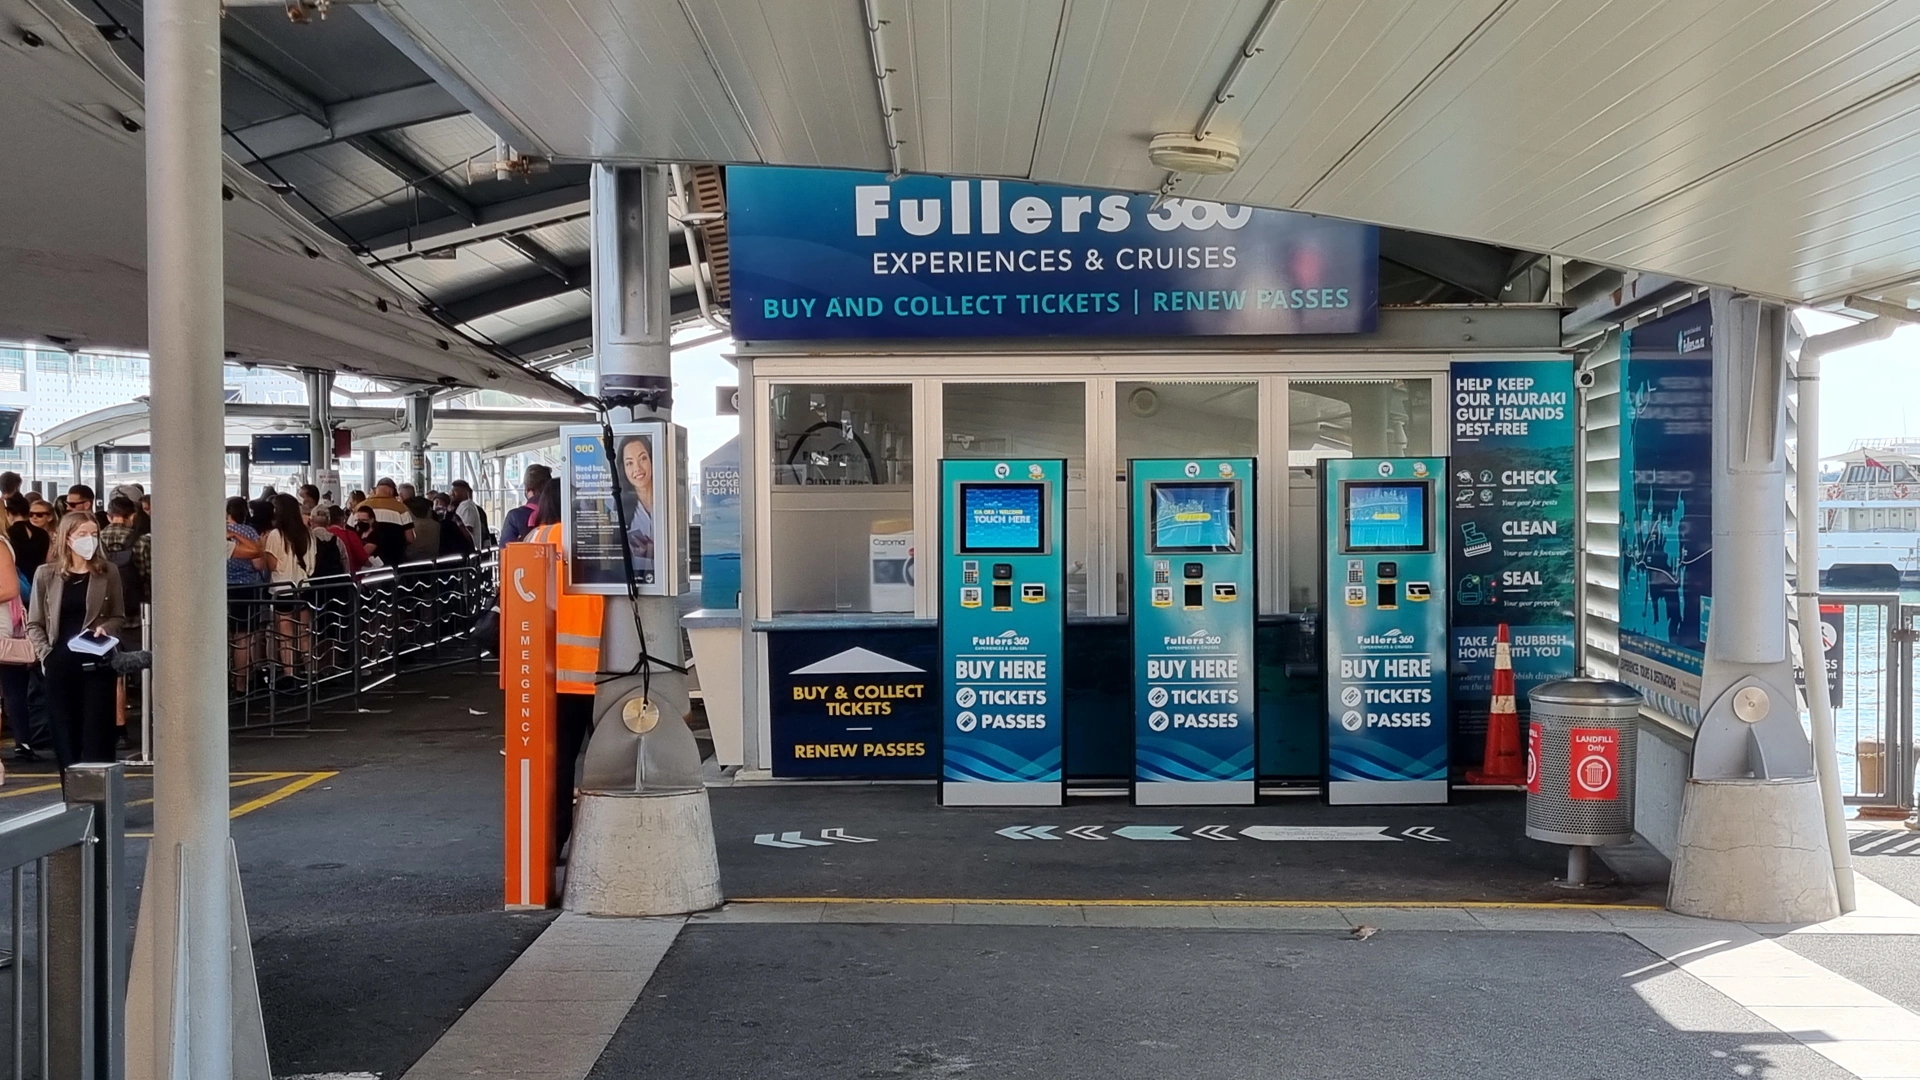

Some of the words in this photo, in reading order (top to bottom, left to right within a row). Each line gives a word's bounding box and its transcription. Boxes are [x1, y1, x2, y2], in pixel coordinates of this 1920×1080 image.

[855, 180, 1131, 237] Fullers
[873, 249, 1073, 275] EXPERIENCES
[1085, 248, 1104, 271] &
[1116, 246, 1237, 270] CRUISES
[764, 298, 816, 319] BUY
[826, 296, 883, 318] AND
[894, 294, 1007, 316] COLLECT
[1016, 292, 1120, 314] TICKETS
[1153, 289, 1247, 312] RENEW
[1257, 287, 1349, 309] PASSES
[1456, 378, 1493, 391] HELP
[1497, 377, 1534, 391] KEEP
[1456, 394, 1491, 406] OUR
[1495, 392, 1566, 405] HAURAKI
[1456, 408, 1495, 421] GULF
[1499, 407, 1564, 420] ISLANDS
[1456, 423, 1528, 436] PEST-FREE
[705, 471, 740, 479] LUGGA
[1501, 470, 1559, 485] CHECK
[706, 479, 740, 488] LOCKE
[706, 487, 728, 496] FOR
[729, 487, 740, 495] HI
[974, 515, 1006, 523] TOUCH
[1008, 515, 1031, 523] HERE
[1502, 521, 1557, 535] CLEAN
[1502, 571, 1543, 586] SEAL
[973, 636, 1013, 645] Fullers
[1013, 636, 1030, 645] 360
[1164, 636, 1204, 645] Fullers
[1204, 636, 1221, 645] 360
[1357, 635, 1398, 644] Fullers
[1398, 635, 1415, 644] 360
[1458, 636, 1487, 646] TAKE
[1515, 635, 1567, 646] RUBBISH
[1458, 648, 1495, 658] HOME
[1509, 647, 1530, 657] ITH
[1534, 647, 1561, 657] YOU
[956, 660, 995, 679] BUY
[999, 661, 1046, 679] HERE
[1147, 660, 1186, 679] BUY
[1191, 660, 1238, 678] HERE
[1340, 659, 1379, 678] BUY
[1384, 659, 1431, 677] HERE
[1513, 672, 1534, 680] bbish
[520, 621, 530, 747] EMERGENCY
[793, 686, 829, 700] BUY
[834, 686, 848, 700] &
[854, 685, 925, 699] COLLECT
[979, 690, 1047, 705] TICKETS
[1172, 690, 1239, 705] TICKETS
[1365, 689, 1432, 704] TICKETS
[826, 702, 892, 716] TICKETS
[981, 714, 1046, 729] PASSES
[1173, 714, 1238, 728] PASSES
[1367, 713, 1432, 728] PASSES
[794, 744, 858, 758] RENEW
[863, 743, 925, 757] PASSES
[1587, 745, 1605, 753] Only
